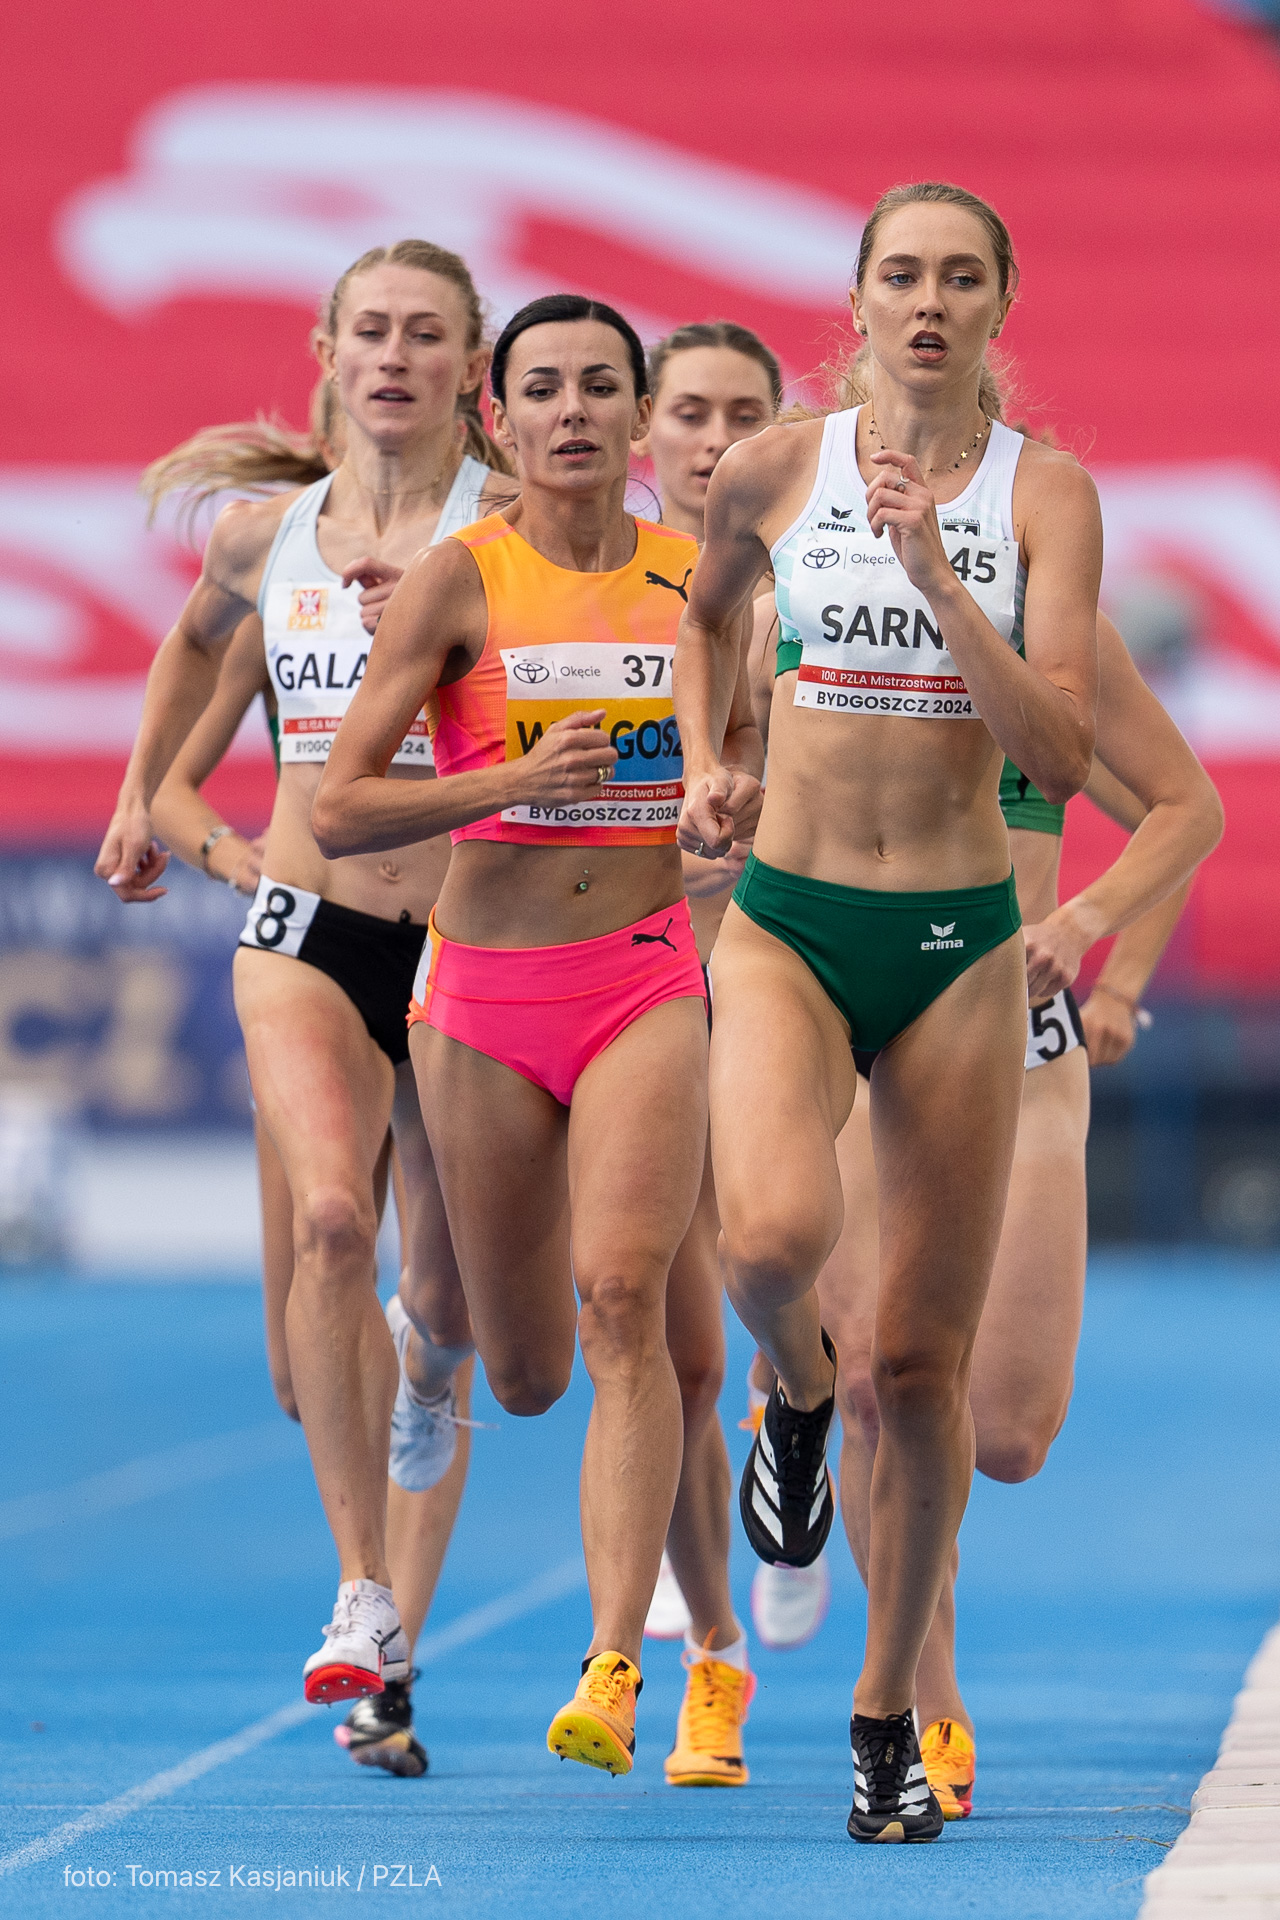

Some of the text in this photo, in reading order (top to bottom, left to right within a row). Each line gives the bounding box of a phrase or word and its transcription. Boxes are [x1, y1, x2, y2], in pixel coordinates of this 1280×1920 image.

[817, 521, 856, 533] erima
[851, 552, 896, 566] Okęcie
[821, 604, 949, 652] SARN
[560, 655, 673, 688] Okęcie 37
[821, 670, 838, 682] 100.
[840, 673, 867, 685] PZLA
[870, 675, 942, 690] Mistrzostwa
[816, 690, 973, 714] BYDGOSZCZ 2024
[595, 785, 677, 798] strzostwa Polski
[529, 805, 679, 822] BYDGOSZCZ 2024
[256, 887, 296, 947] 8
[921, 938, 963, 951] erima
[1031, 998, 1067, 1061] 5
